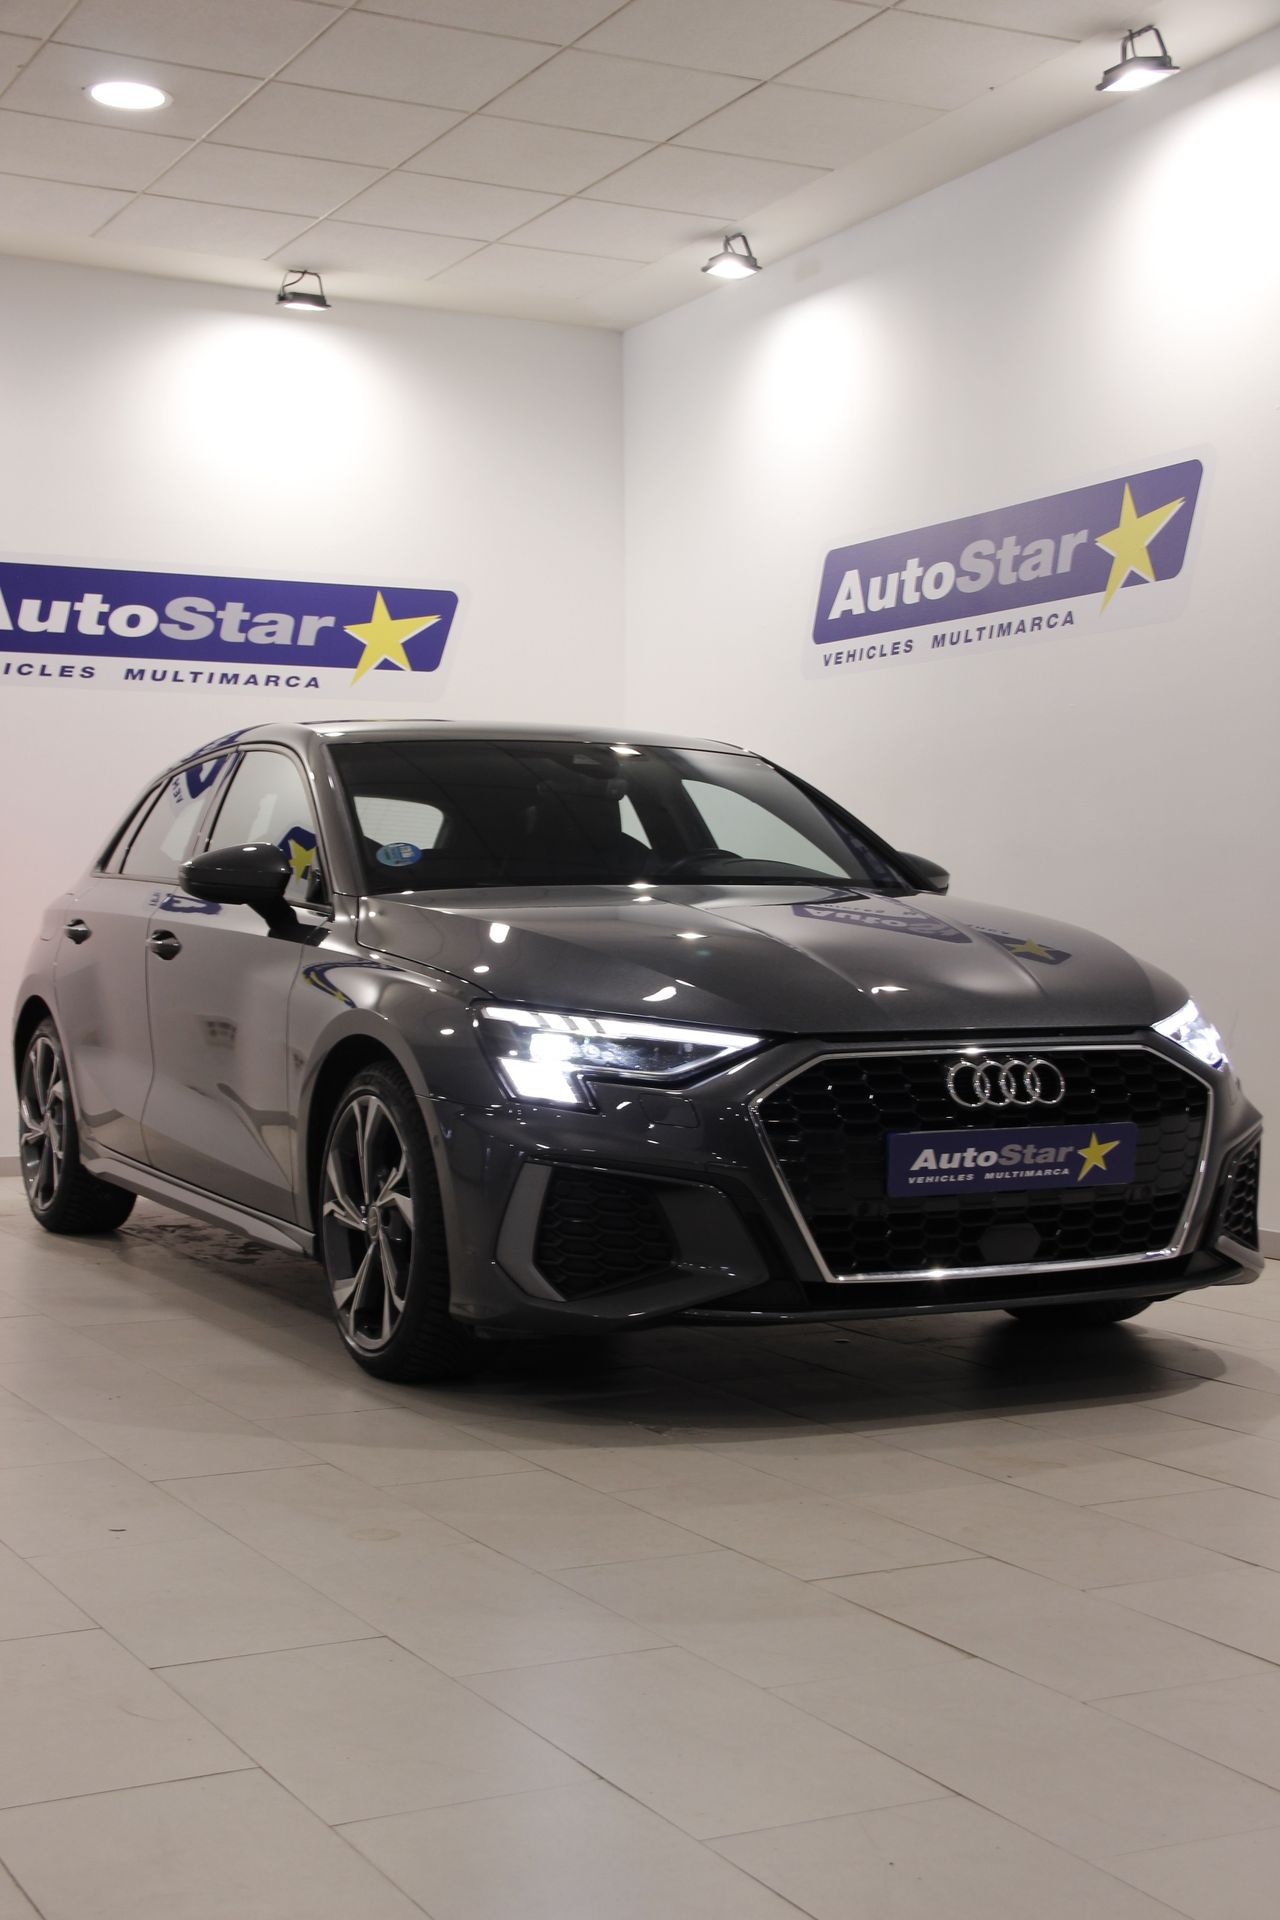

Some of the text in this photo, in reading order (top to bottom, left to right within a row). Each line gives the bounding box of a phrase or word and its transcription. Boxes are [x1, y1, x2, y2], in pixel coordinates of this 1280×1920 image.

[828, 529, 1088, 620] AutoStar
[823, 611, 1075, 667] VEHICLES MULTIMARCA
[123, 668, 320, 689] MULTIMARCA
[909, 1144, 1075, 1171] AutoStar
[907, 1168, 1070, 1184] VEHICLES MULTIMARCA
